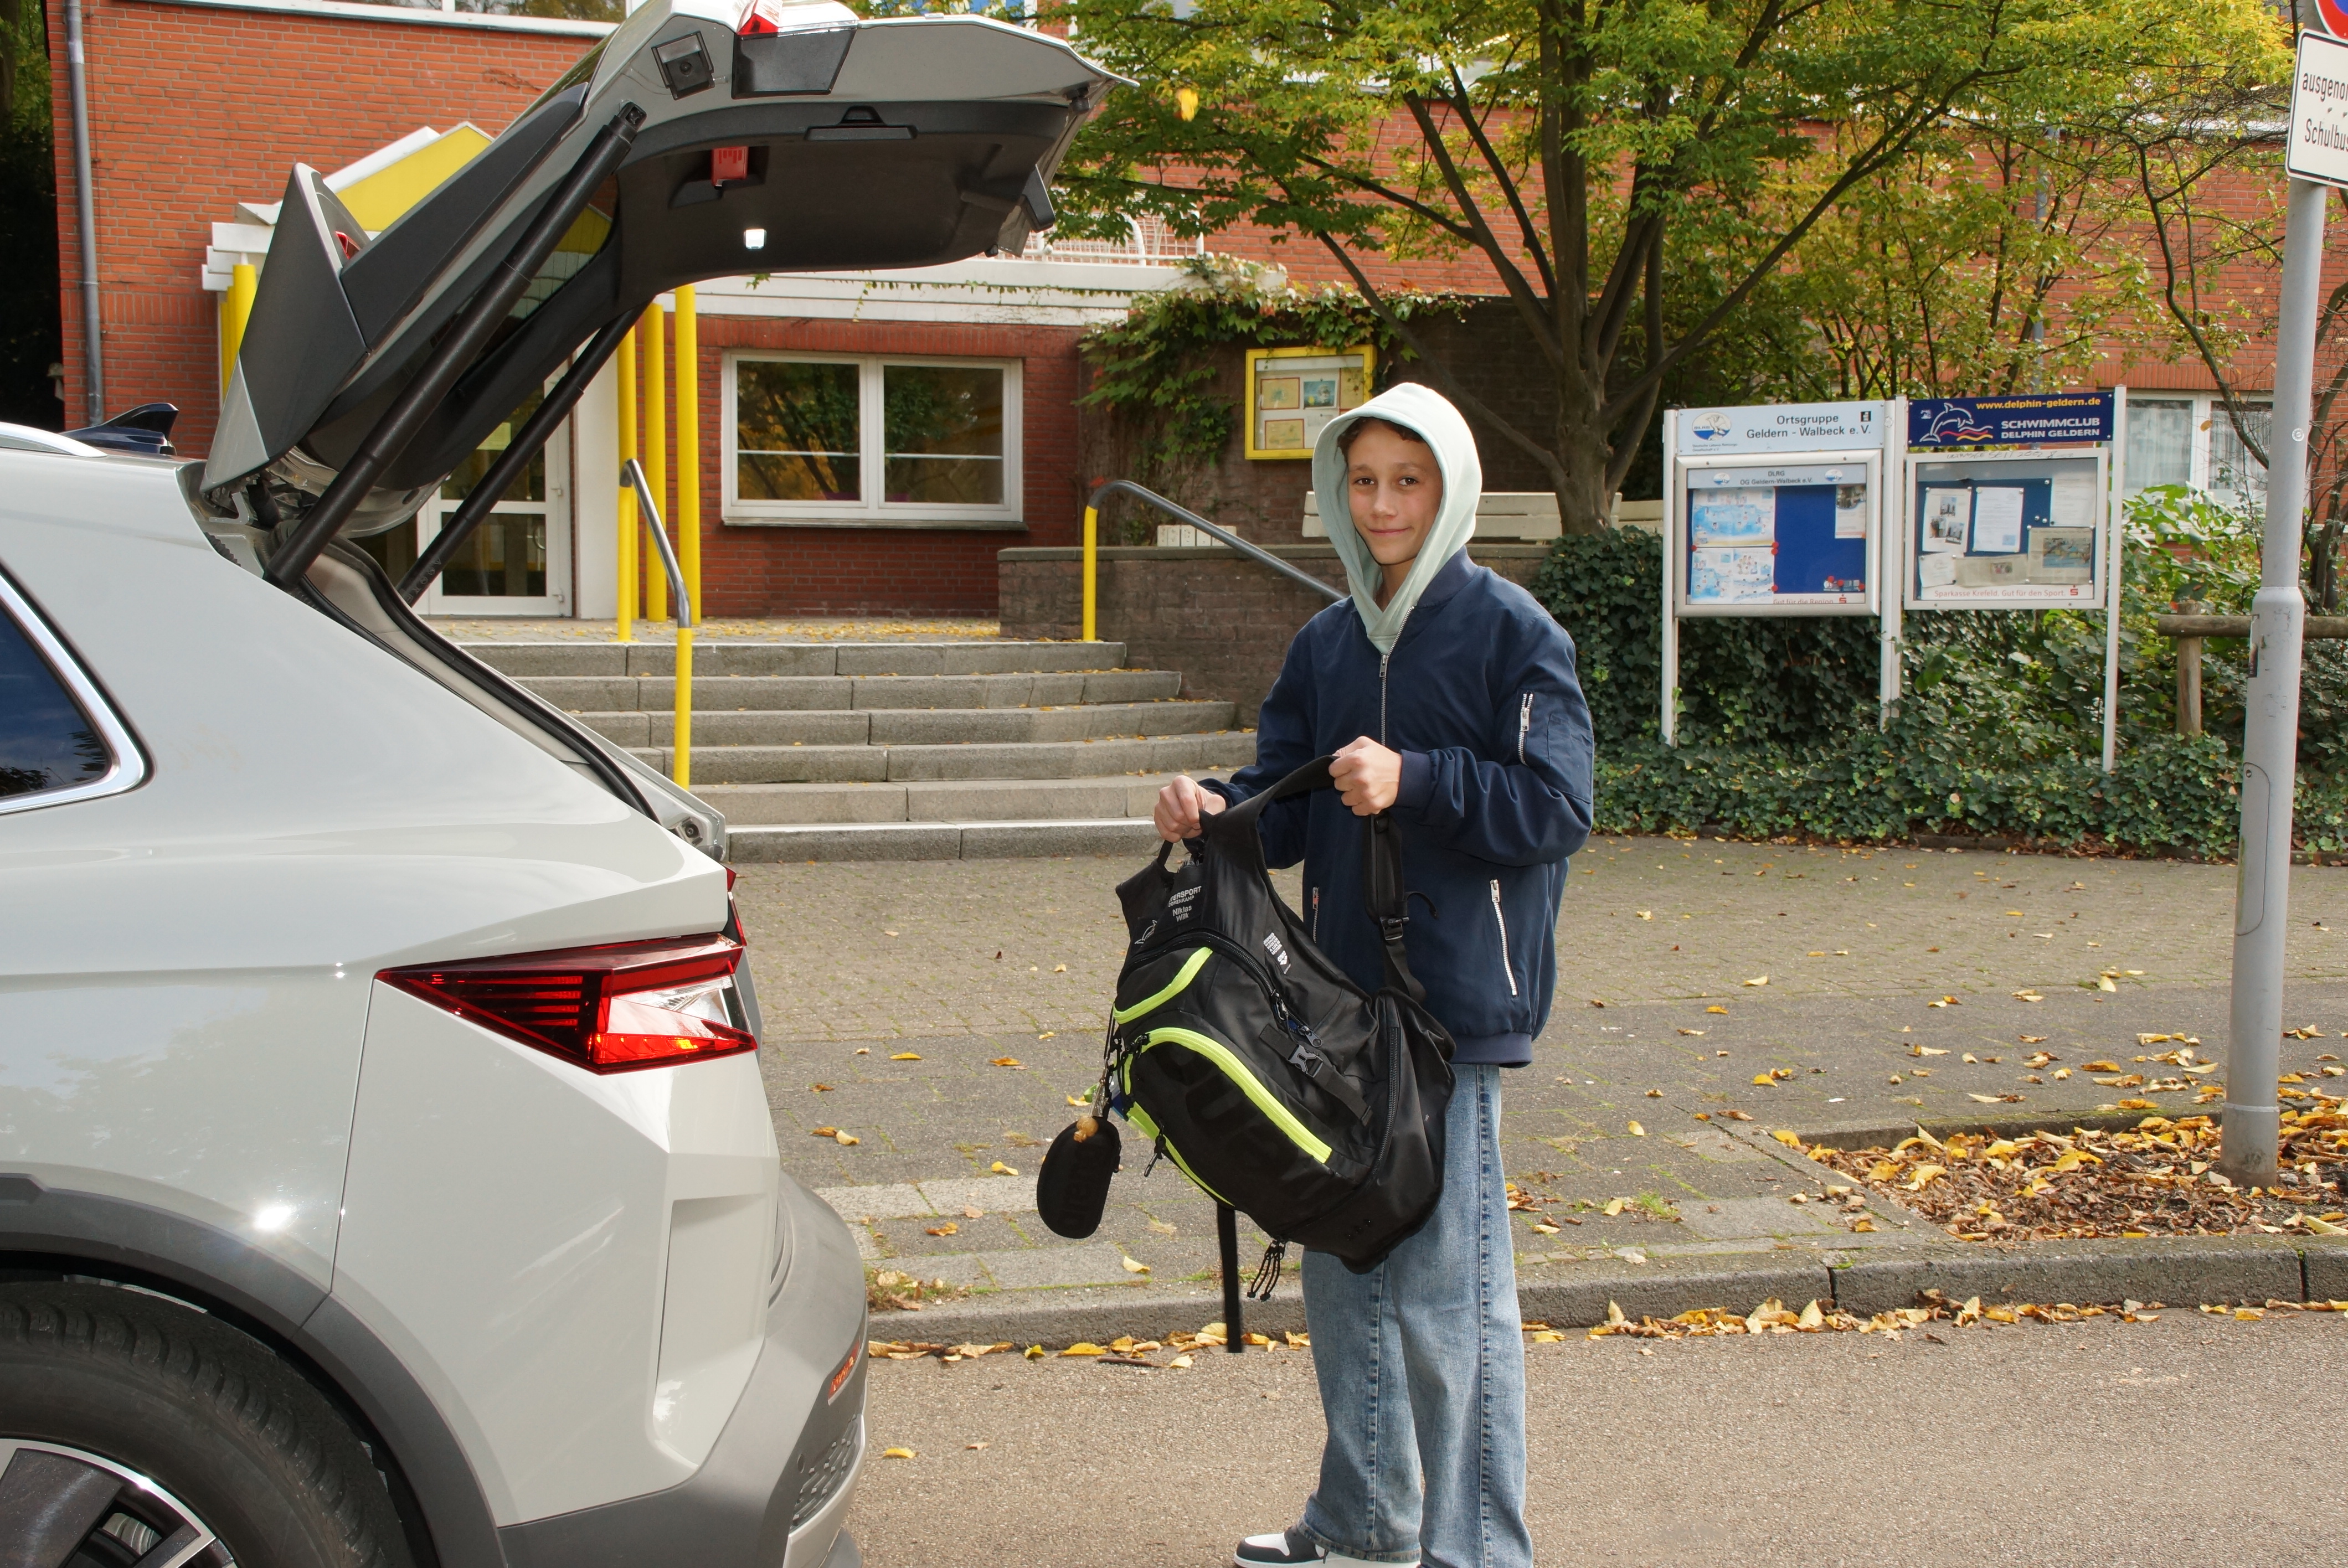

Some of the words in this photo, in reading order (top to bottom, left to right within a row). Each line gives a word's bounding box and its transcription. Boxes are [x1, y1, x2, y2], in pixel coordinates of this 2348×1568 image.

[2303, 73, 2348, 102] ausgeno
[1976, 398, 2100, 409] www.delphin-geldern.de
[1777, 415, 1839, 426] Ortsgruppe
[2001, 417, 2100, 429] SCHWIMMCLUB
[1747, 429, 1788, 439] Geldern
[1799, 426, 1845, 436] Walbeck
[2048, 429, 2099, 437] GELDERN
[1934, 590, 1970, 598] Sparkasse
[1169, 886, 1202, 903] TERSPORT
[1172, 905, 1192, 916] Niklas
[1176, 912, 1189, 922] Wilk
